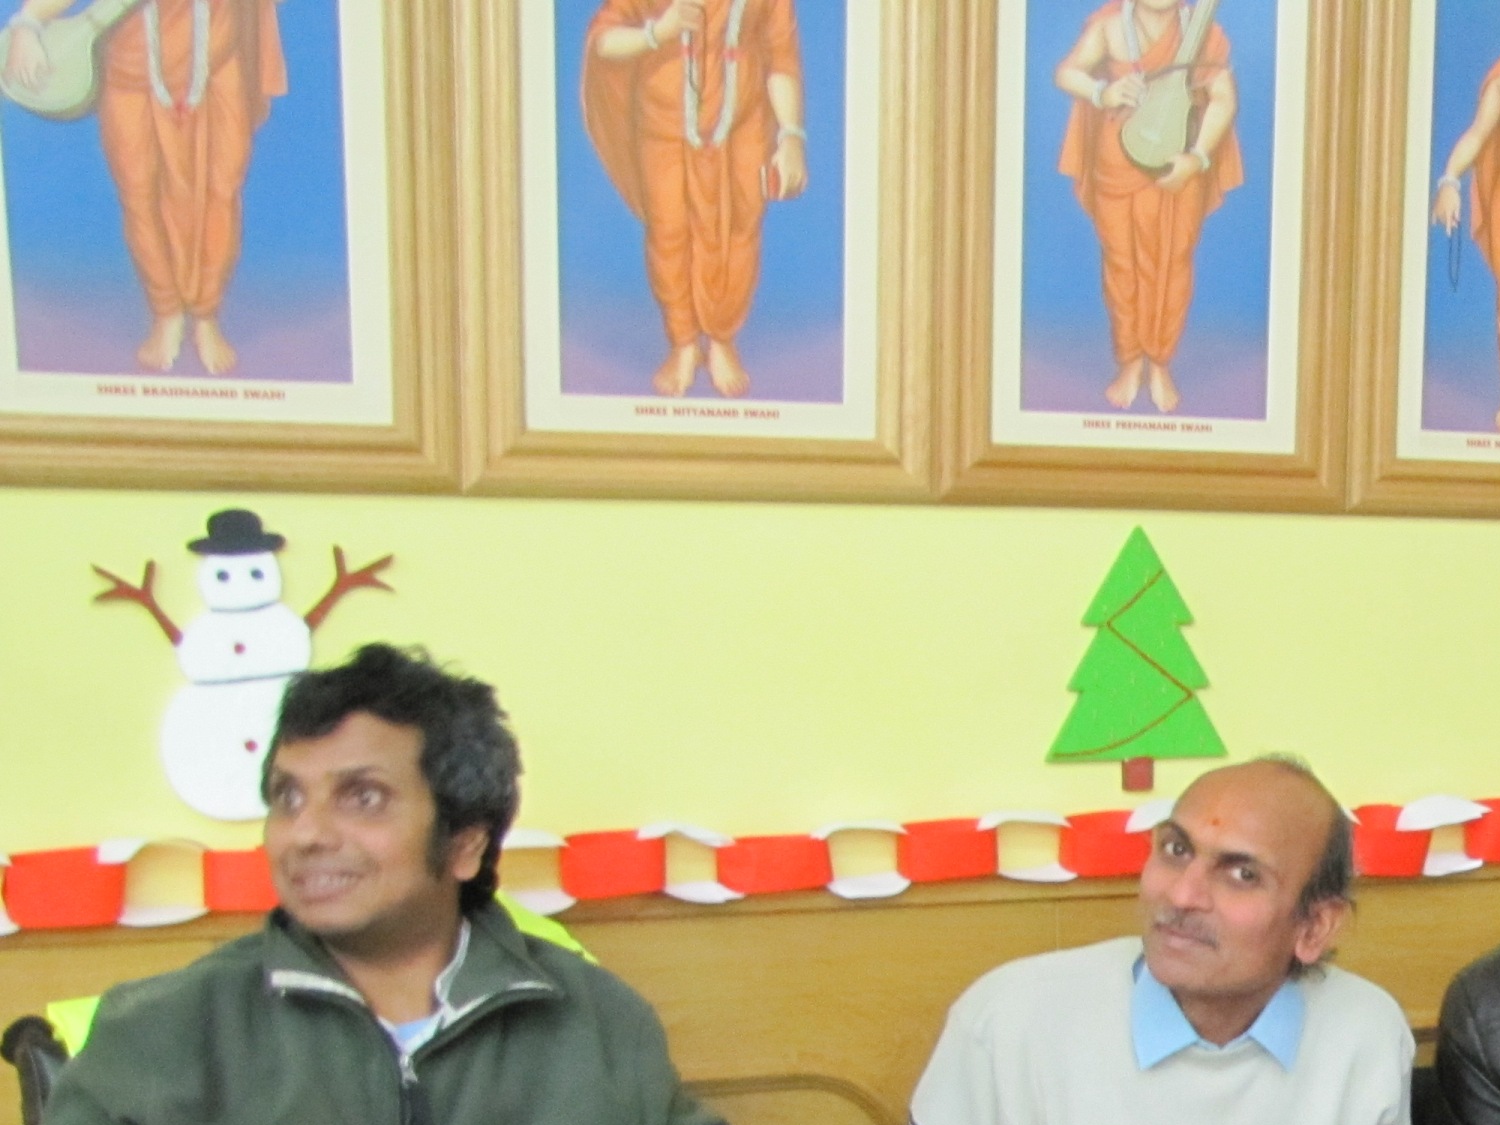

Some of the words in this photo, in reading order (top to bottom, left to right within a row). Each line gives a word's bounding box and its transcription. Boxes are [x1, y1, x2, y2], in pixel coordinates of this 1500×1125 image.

[243, 388, 286, 400] SWAMI
[743, 408, 780, 419] SWAMI
[1181, 423, 1213, 433] SWAMI
